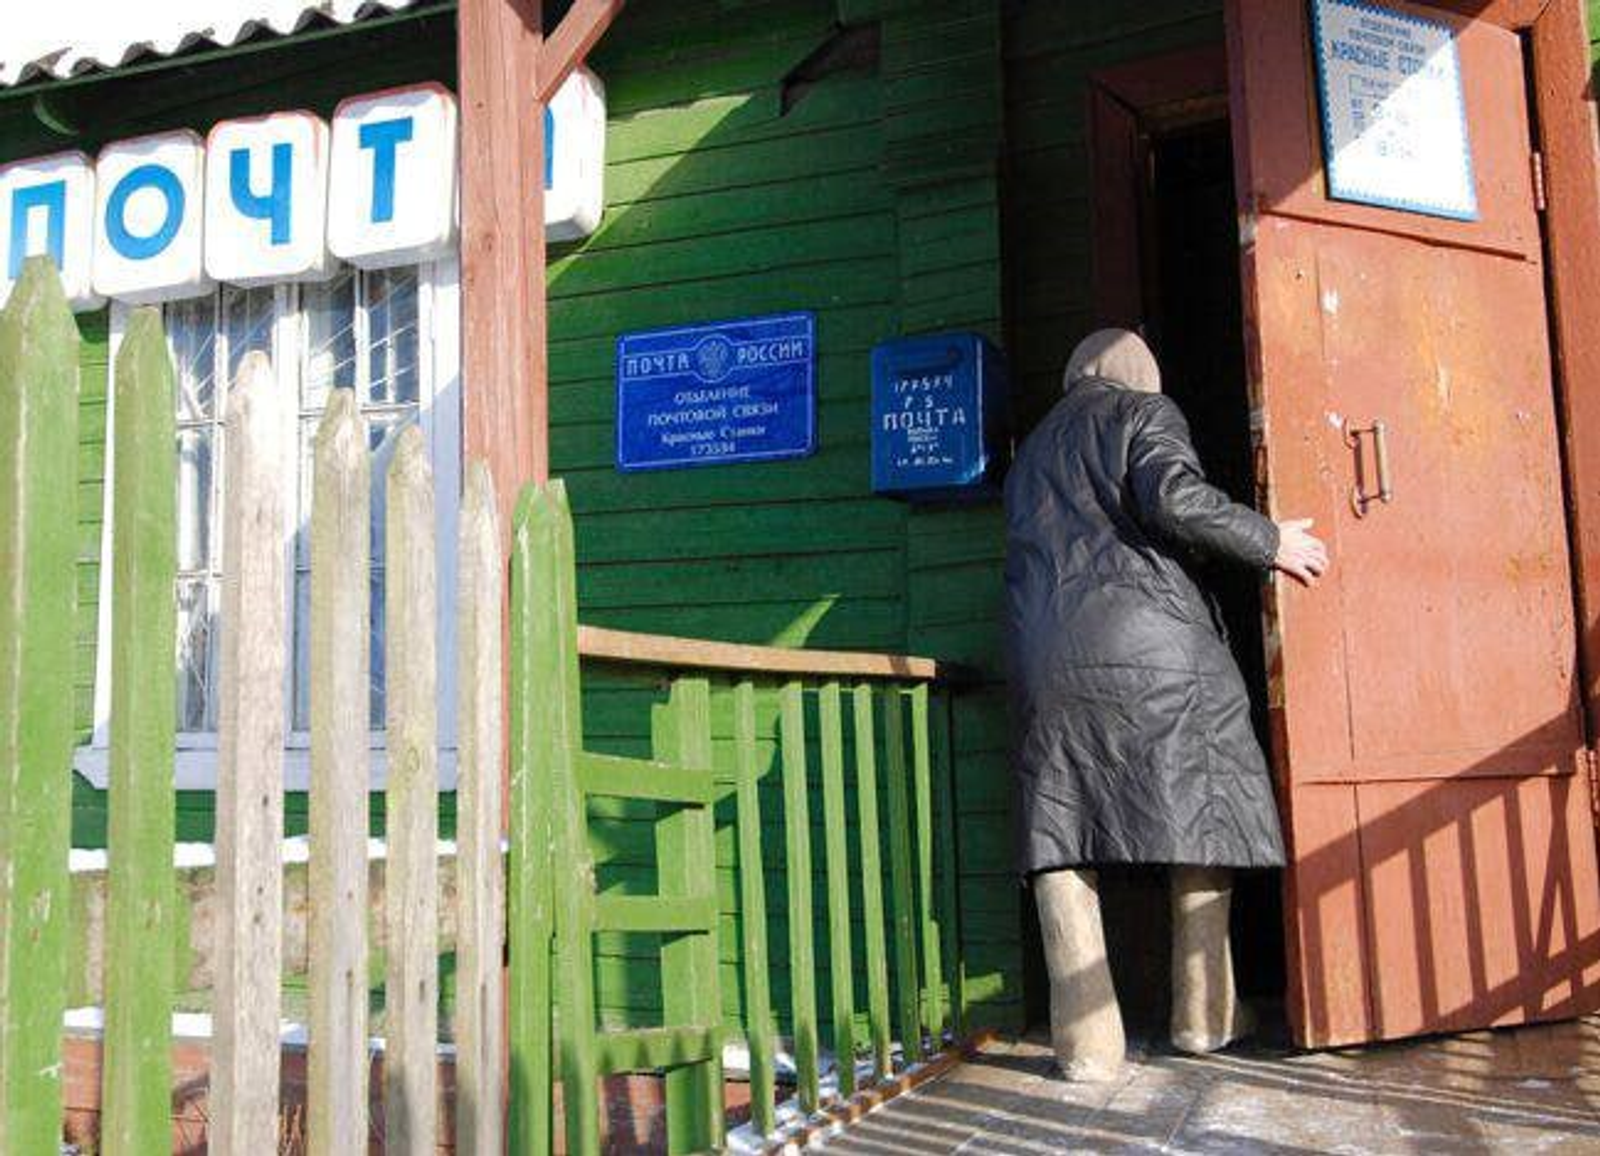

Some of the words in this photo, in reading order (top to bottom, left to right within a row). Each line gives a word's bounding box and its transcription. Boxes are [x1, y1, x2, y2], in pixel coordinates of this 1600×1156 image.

[626, 352, 690, 376] ПОЧТА
[736, 340, 804, 364] РОССИИ
[648, 405, 727, 426] ПОЧТОВОЙ
[883, 407, 967, 431] ПОЧТА
